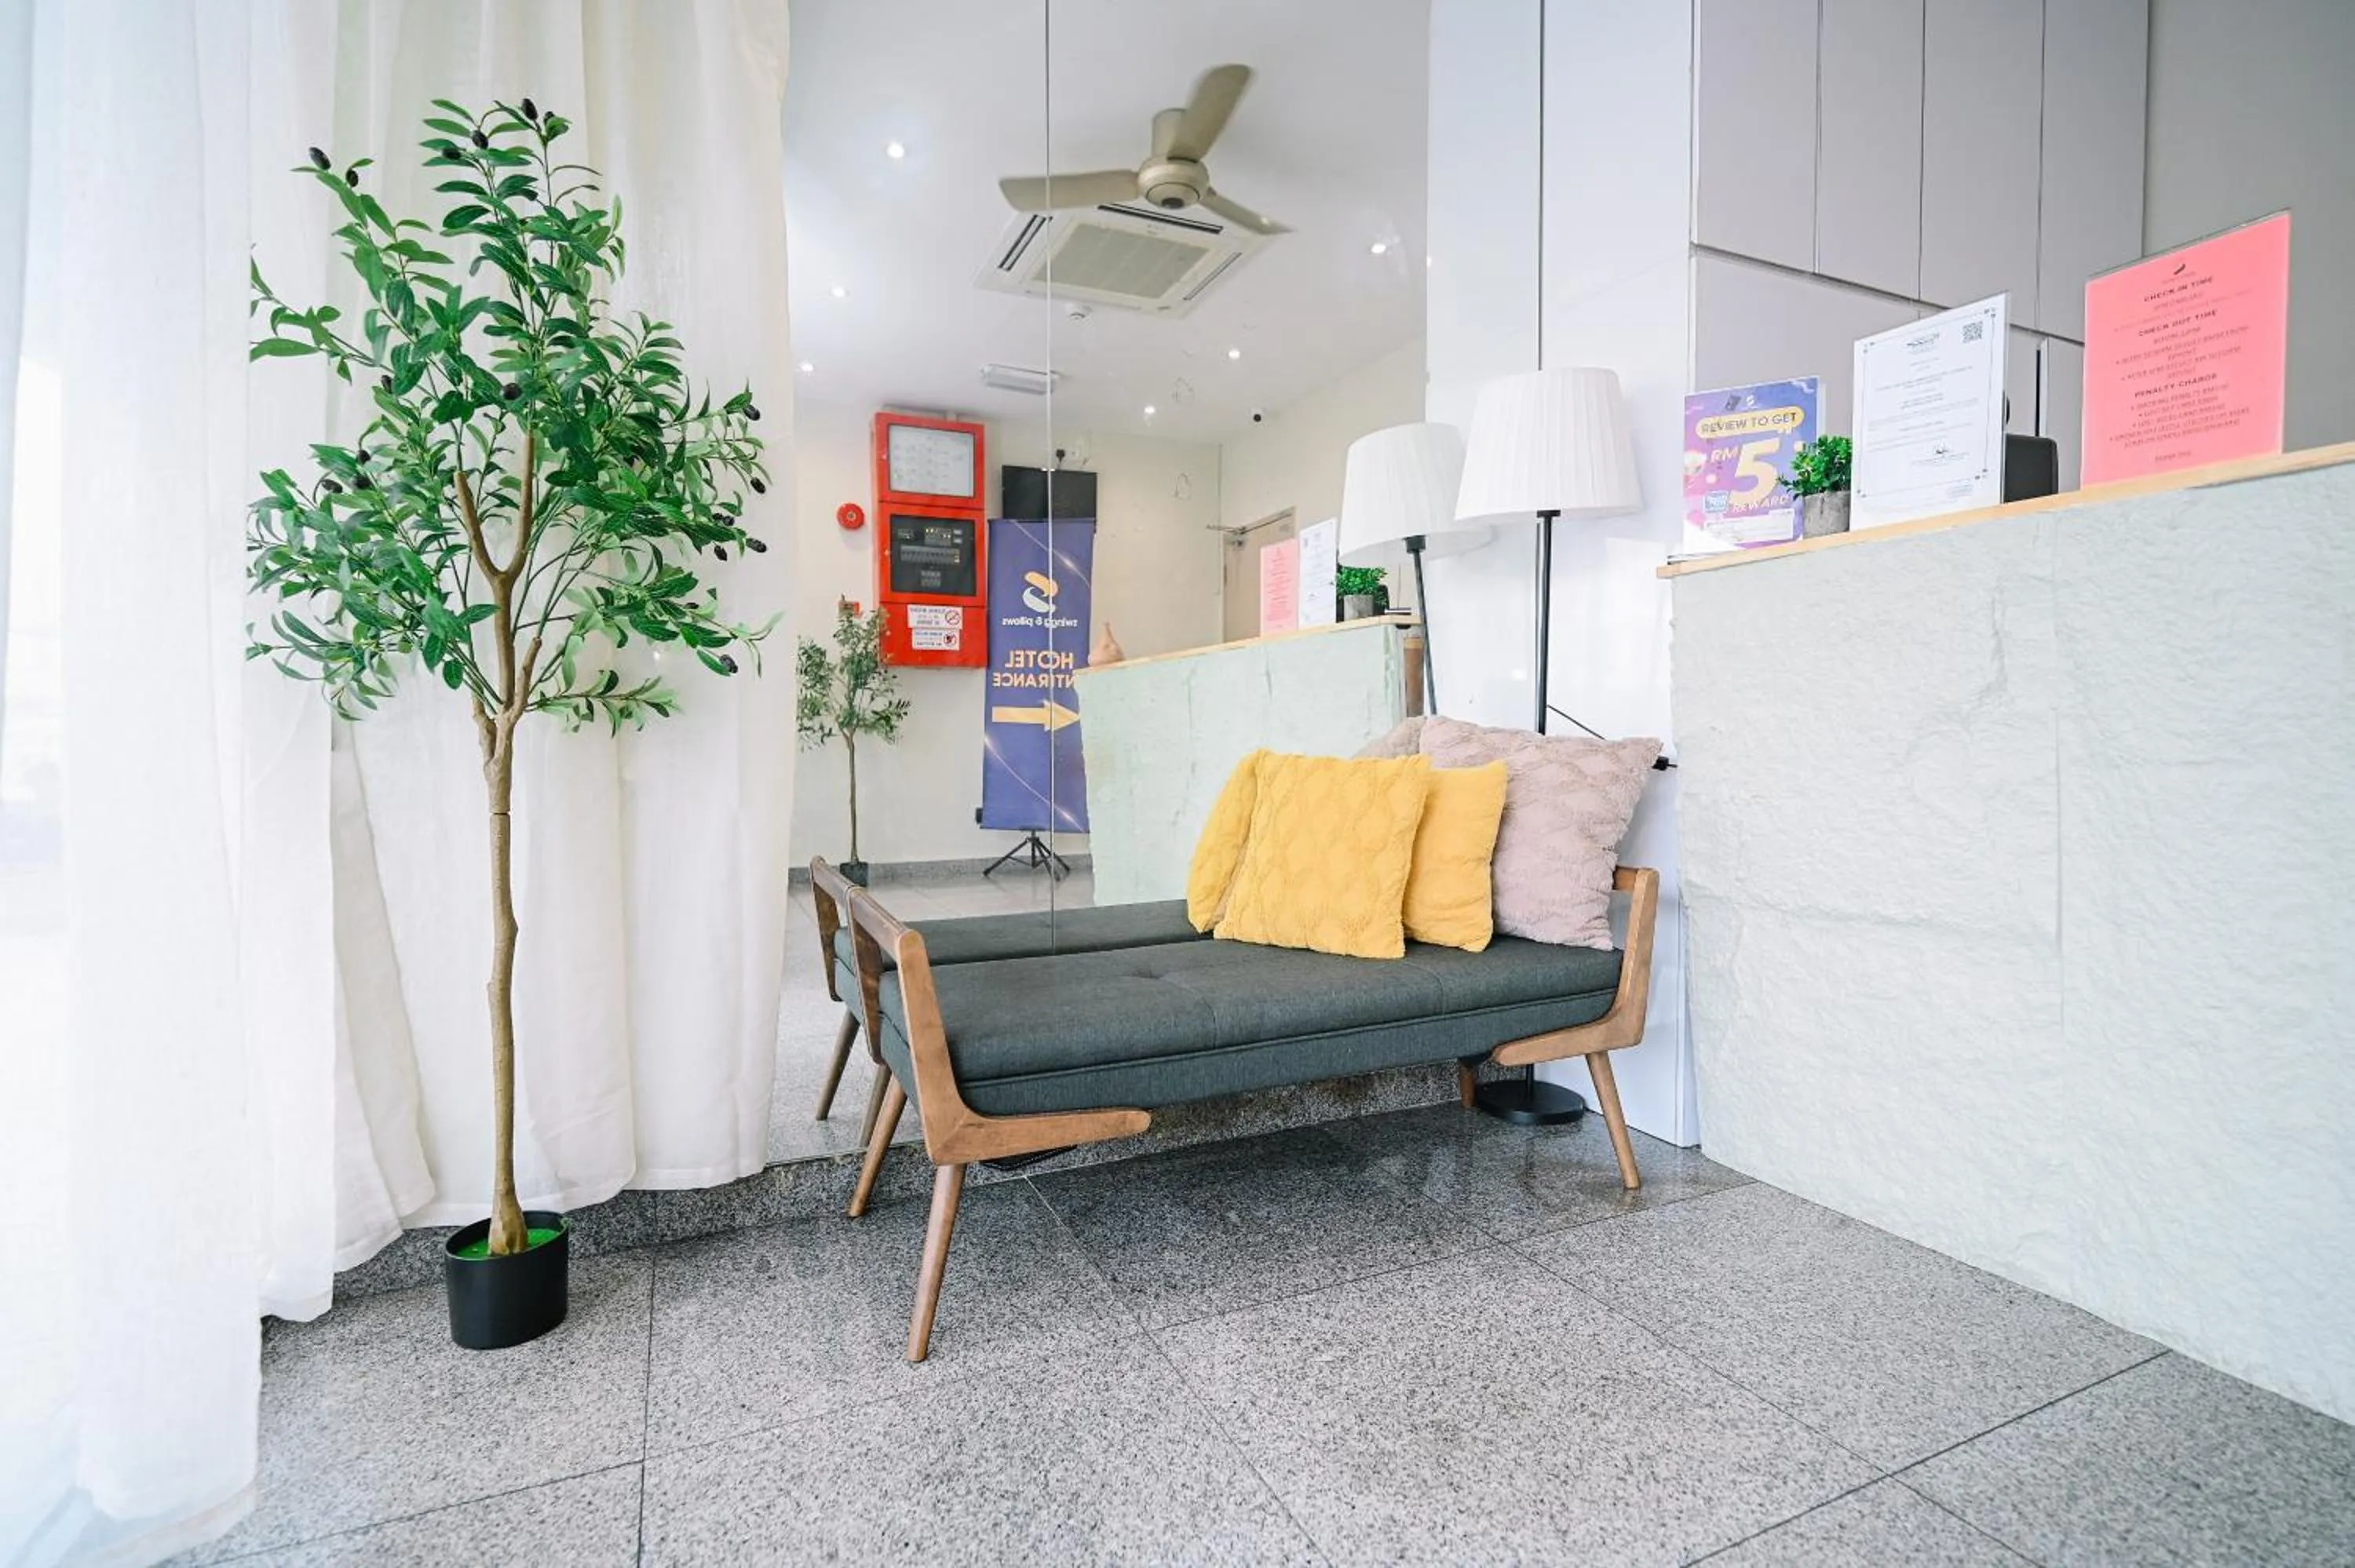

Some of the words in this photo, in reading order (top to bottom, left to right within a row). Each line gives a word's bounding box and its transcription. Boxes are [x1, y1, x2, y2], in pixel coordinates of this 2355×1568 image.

[2144, 288, 2175, 302] CHECK
[2191, 275, 2213, 288] TIME
[2138, 323, 2169, 337] CHECK
[2172, 316, 2191, 327] OUT
[2195, 308, 2218, 320] TIME
[2134, 382, 2175, 398] PENALTY
[2178, 373, 2218, 388] CHARGE
[1702, 419, 1747, 432] REVIEW
[1751, 417, 1769, 428] TO
[1773, 412, 1797, 425] GET
[1711, 447, 1738, 464] RM
[1729, 437, 1780, 506] 5
[1732, 495, 1789, 512] REWARD
